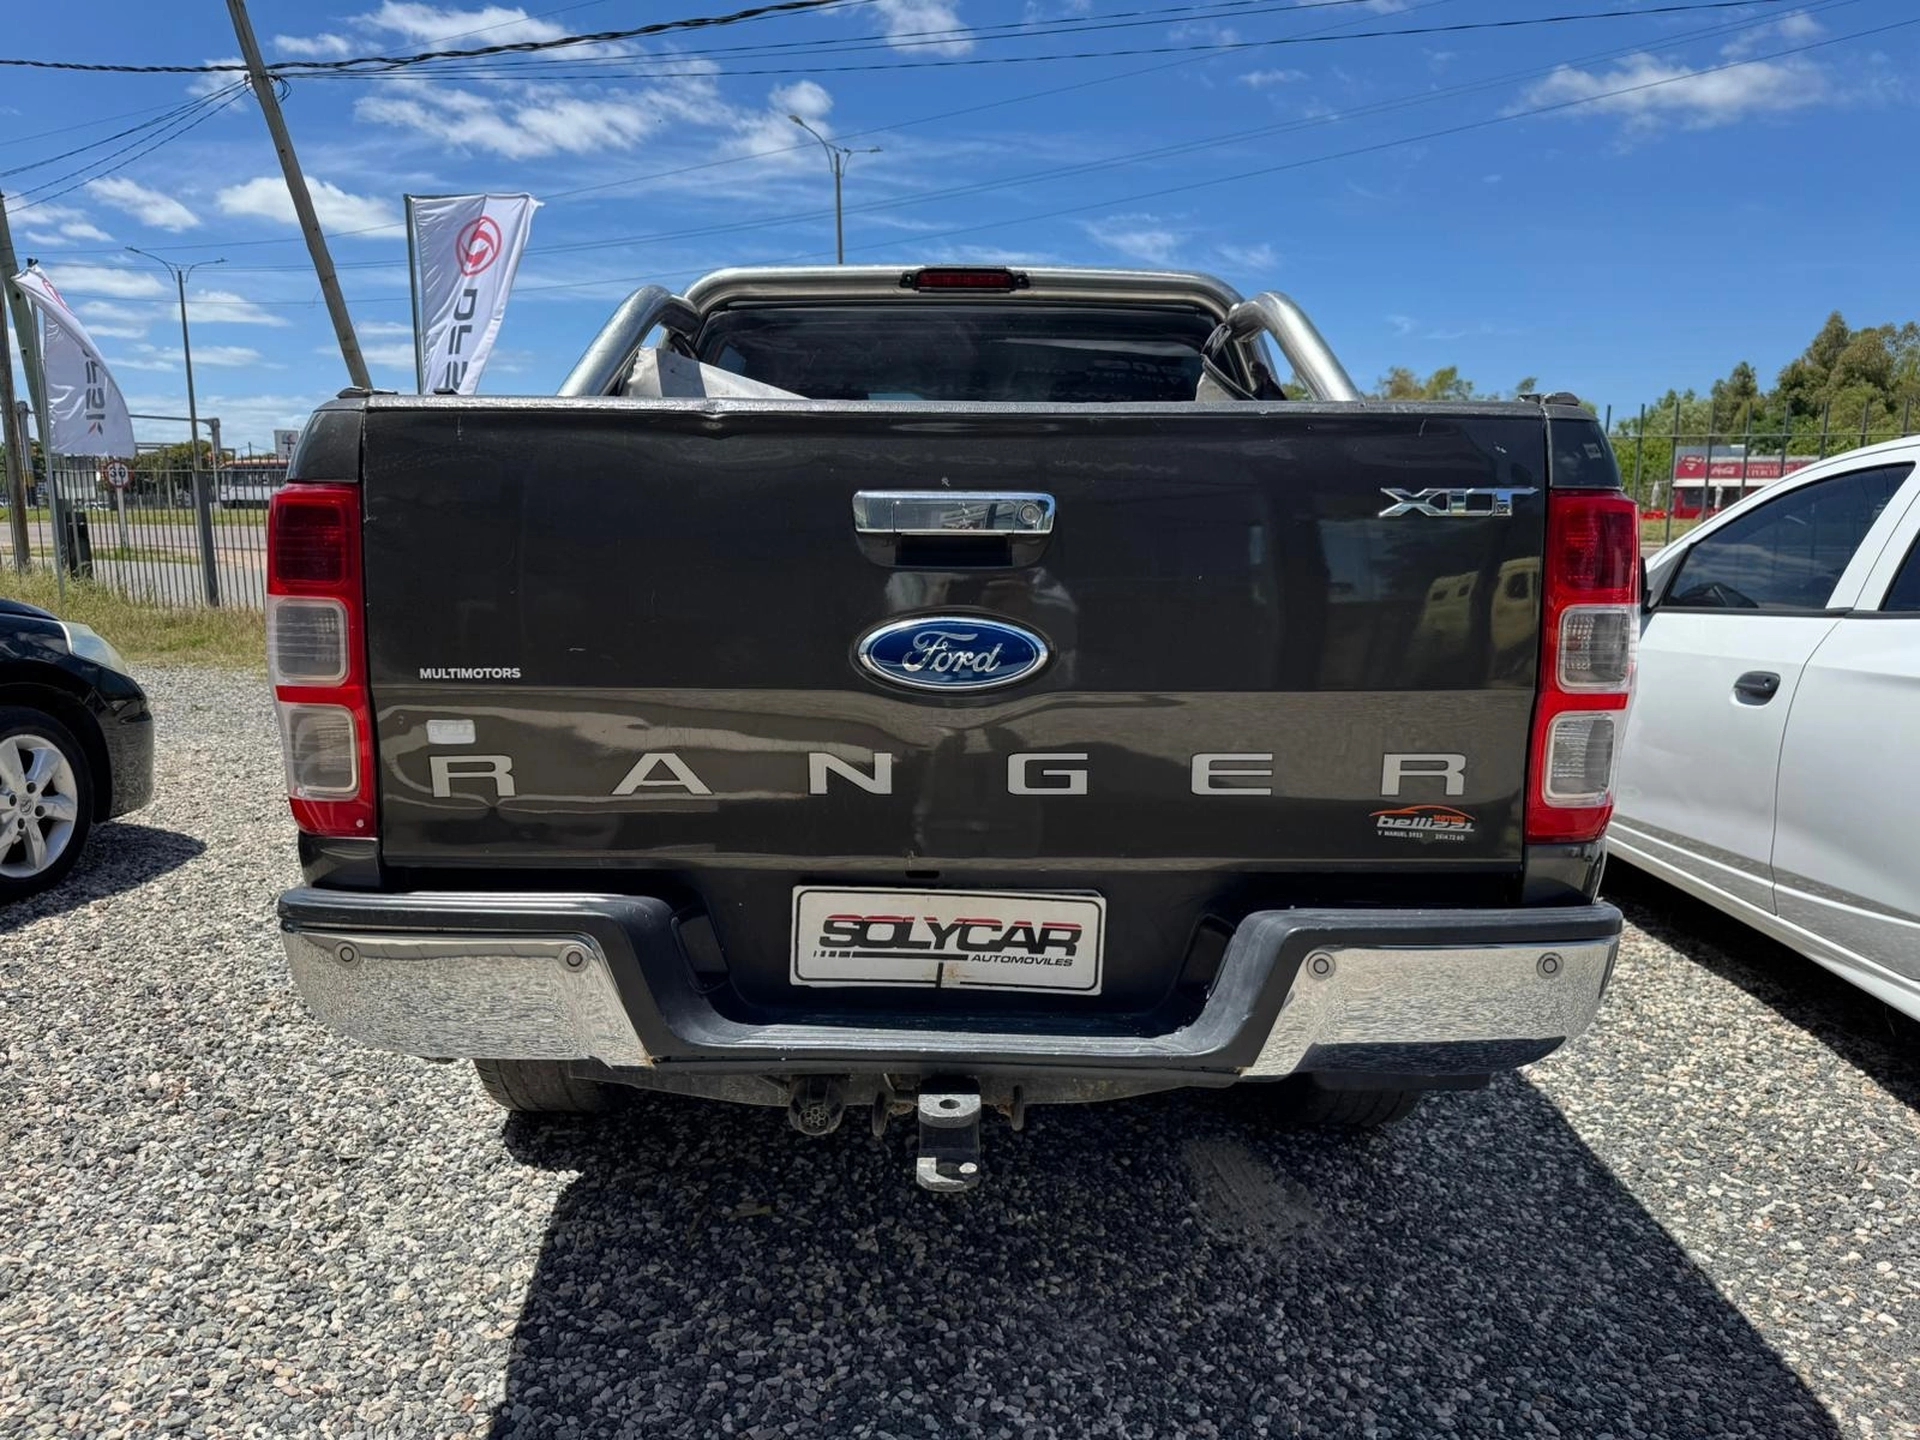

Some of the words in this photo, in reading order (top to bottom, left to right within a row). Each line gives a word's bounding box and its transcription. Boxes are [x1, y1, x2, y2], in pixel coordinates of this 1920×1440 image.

[1378, 487, 1539, 517] XLT
[902, 631, 1003, 673] Ford
[419, 667, 522, 680] MULTIMOTORS
[429, 752, 1467, 798] RANGER
[818, 914, 1083, 956] SOLYCAR
[971, 953, 1074, 968] AUTOMOVILES
